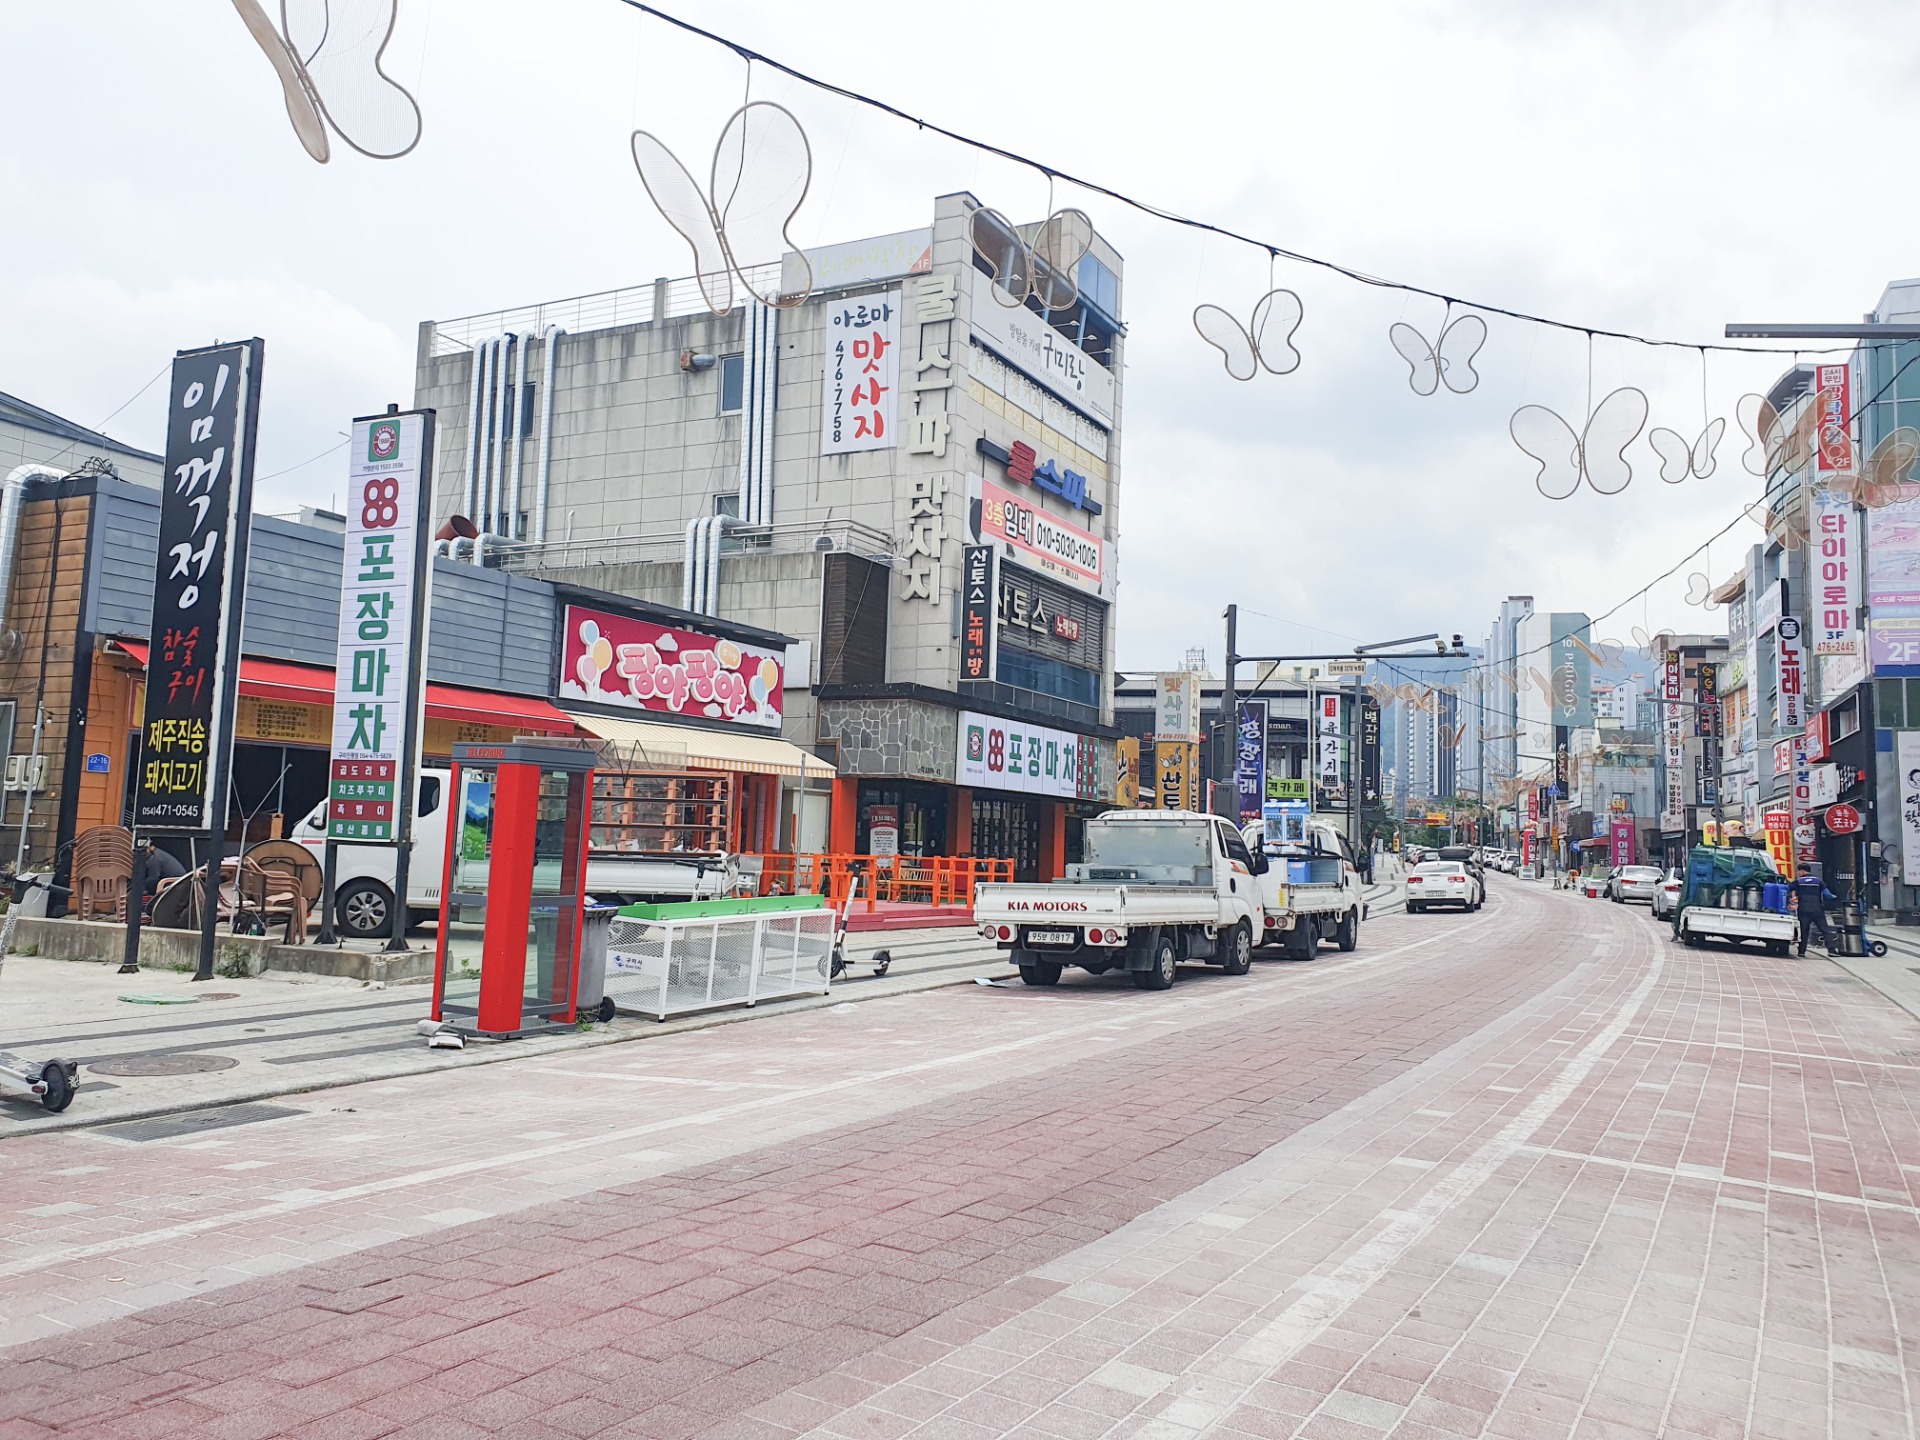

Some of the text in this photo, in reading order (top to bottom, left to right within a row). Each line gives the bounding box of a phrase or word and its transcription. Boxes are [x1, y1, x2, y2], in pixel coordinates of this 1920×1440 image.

[917, 259, 930, 269] 1F
[833, 304, 893, 328] 아로마
[851, 331, 891, 439] 맛사지
[1836, 457, 1851, 467] 2F
[169, 363, 230, 610] 임꺽정
[361, 477, 399, 529] 88
[900, 475, 948, 606] 맛사지
[985, 497, 1097, 571] 3층 임대 010-5030-1006
[969, 549, 988, 604] 산토스
[998, 584, 1049, 634] 산토스
[162, 626, 201, 667] 참숯
[347, 534, 395, 753] 포장마차
[1817, 641, 1855, 652] 476-2445
[1826, 631, 1845, 641] 3F
[1888, 642, 1919, 663] 2F
[619, 643, 746, 716] 팡야팡야
[1781, 640, 1801, 695] 노래
[168, 668, 206, 705] 구이
[1164, 677, 1183, 729] 맛사지
[148, 718, 206, 753] 제주직송
[1365, 711, 1378, 745] 별자리
[90, 756, 108, 764] 22-16
[467, 747, 506, 758] TELEPHONE
[988, 728, 1005, 772] 88
[1008, 734, 1075, 783] 포장마차
[144, 759, 203, 794] 돼지고기
[142, 804, 198, 817] 054)471-0545
[1833, 817, 1857, 829] 포차
[1008, 901, 1030, 910] KIA
[1033, 901, 1088, 911] MOTORS
[1050, 933, 1071, 942] 0817
[625, 957, 643, 965] 구미시
